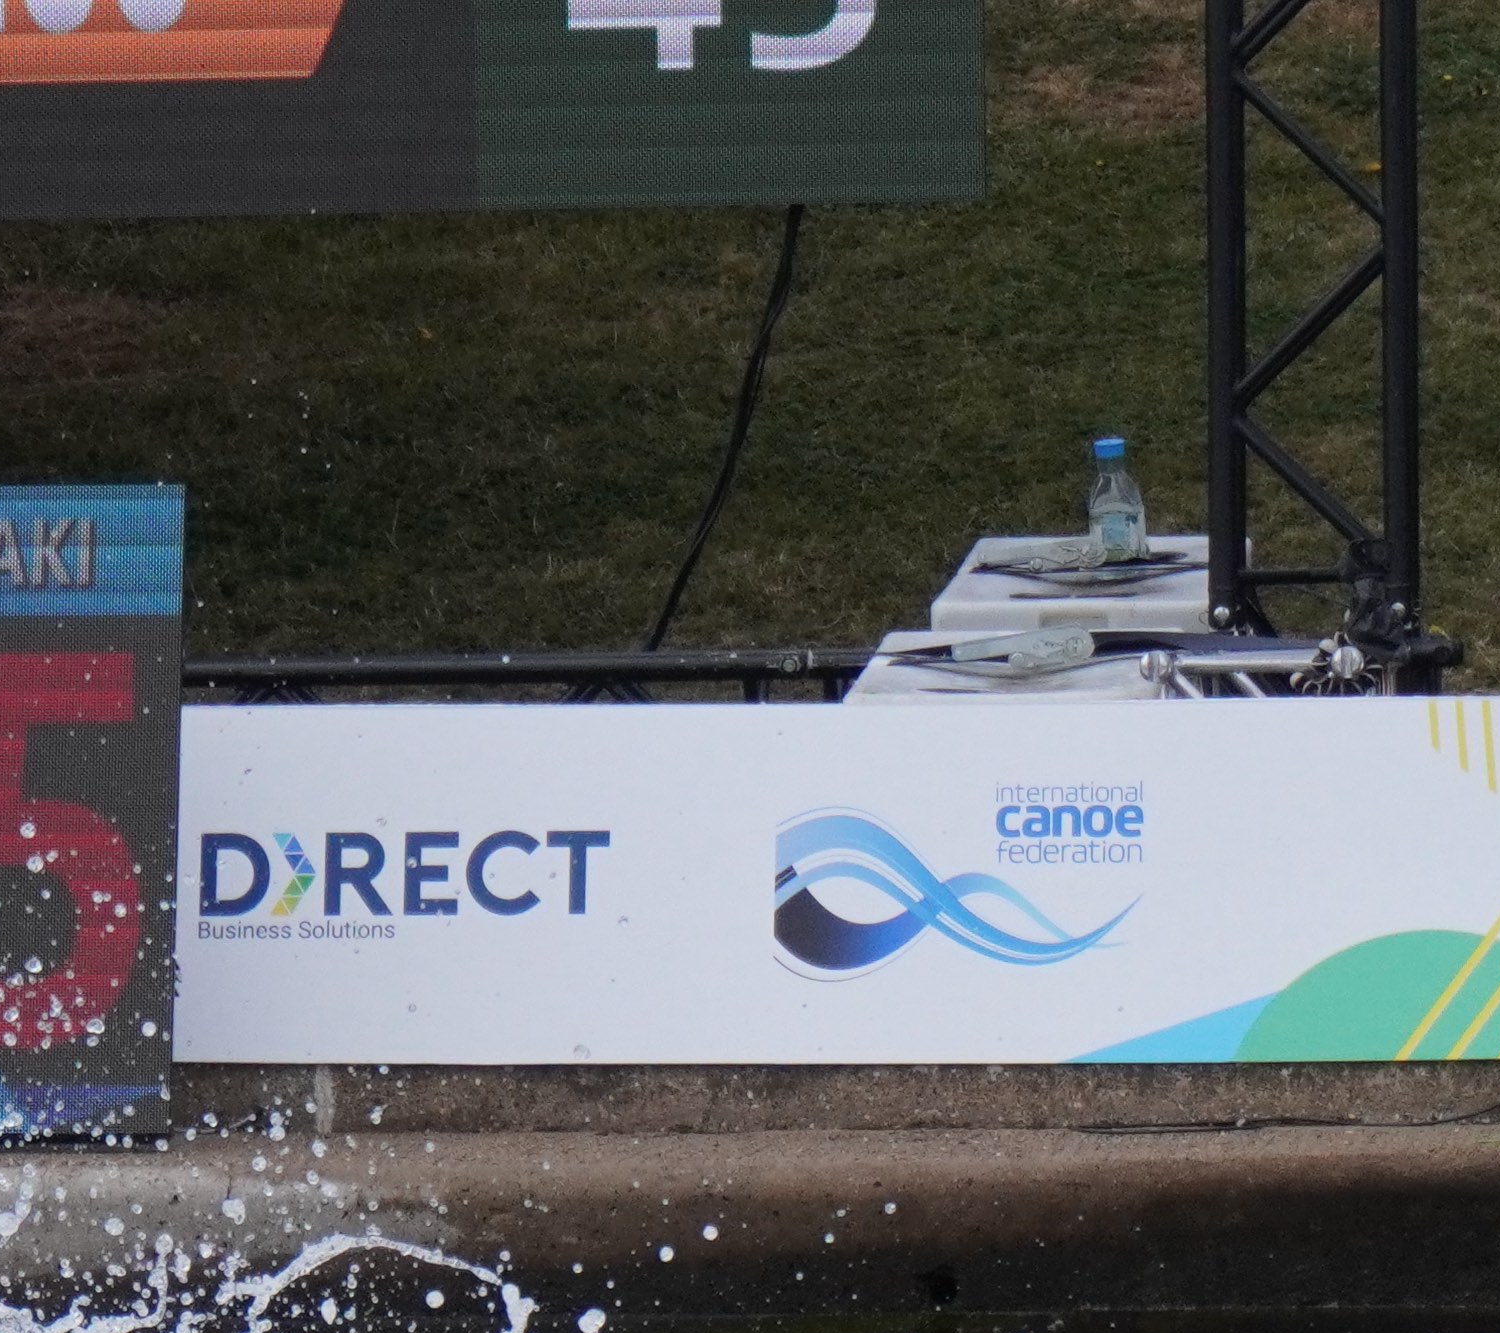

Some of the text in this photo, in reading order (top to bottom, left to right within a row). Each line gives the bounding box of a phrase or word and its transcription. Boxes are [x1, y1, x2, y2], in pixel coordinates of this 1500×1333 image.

[996, 780, 1143, 803] international
[996, 804, 1144, 838] canoe
[998, 840, 1143, 864] federation
[198, 920, 396, 940] Business Solutions
